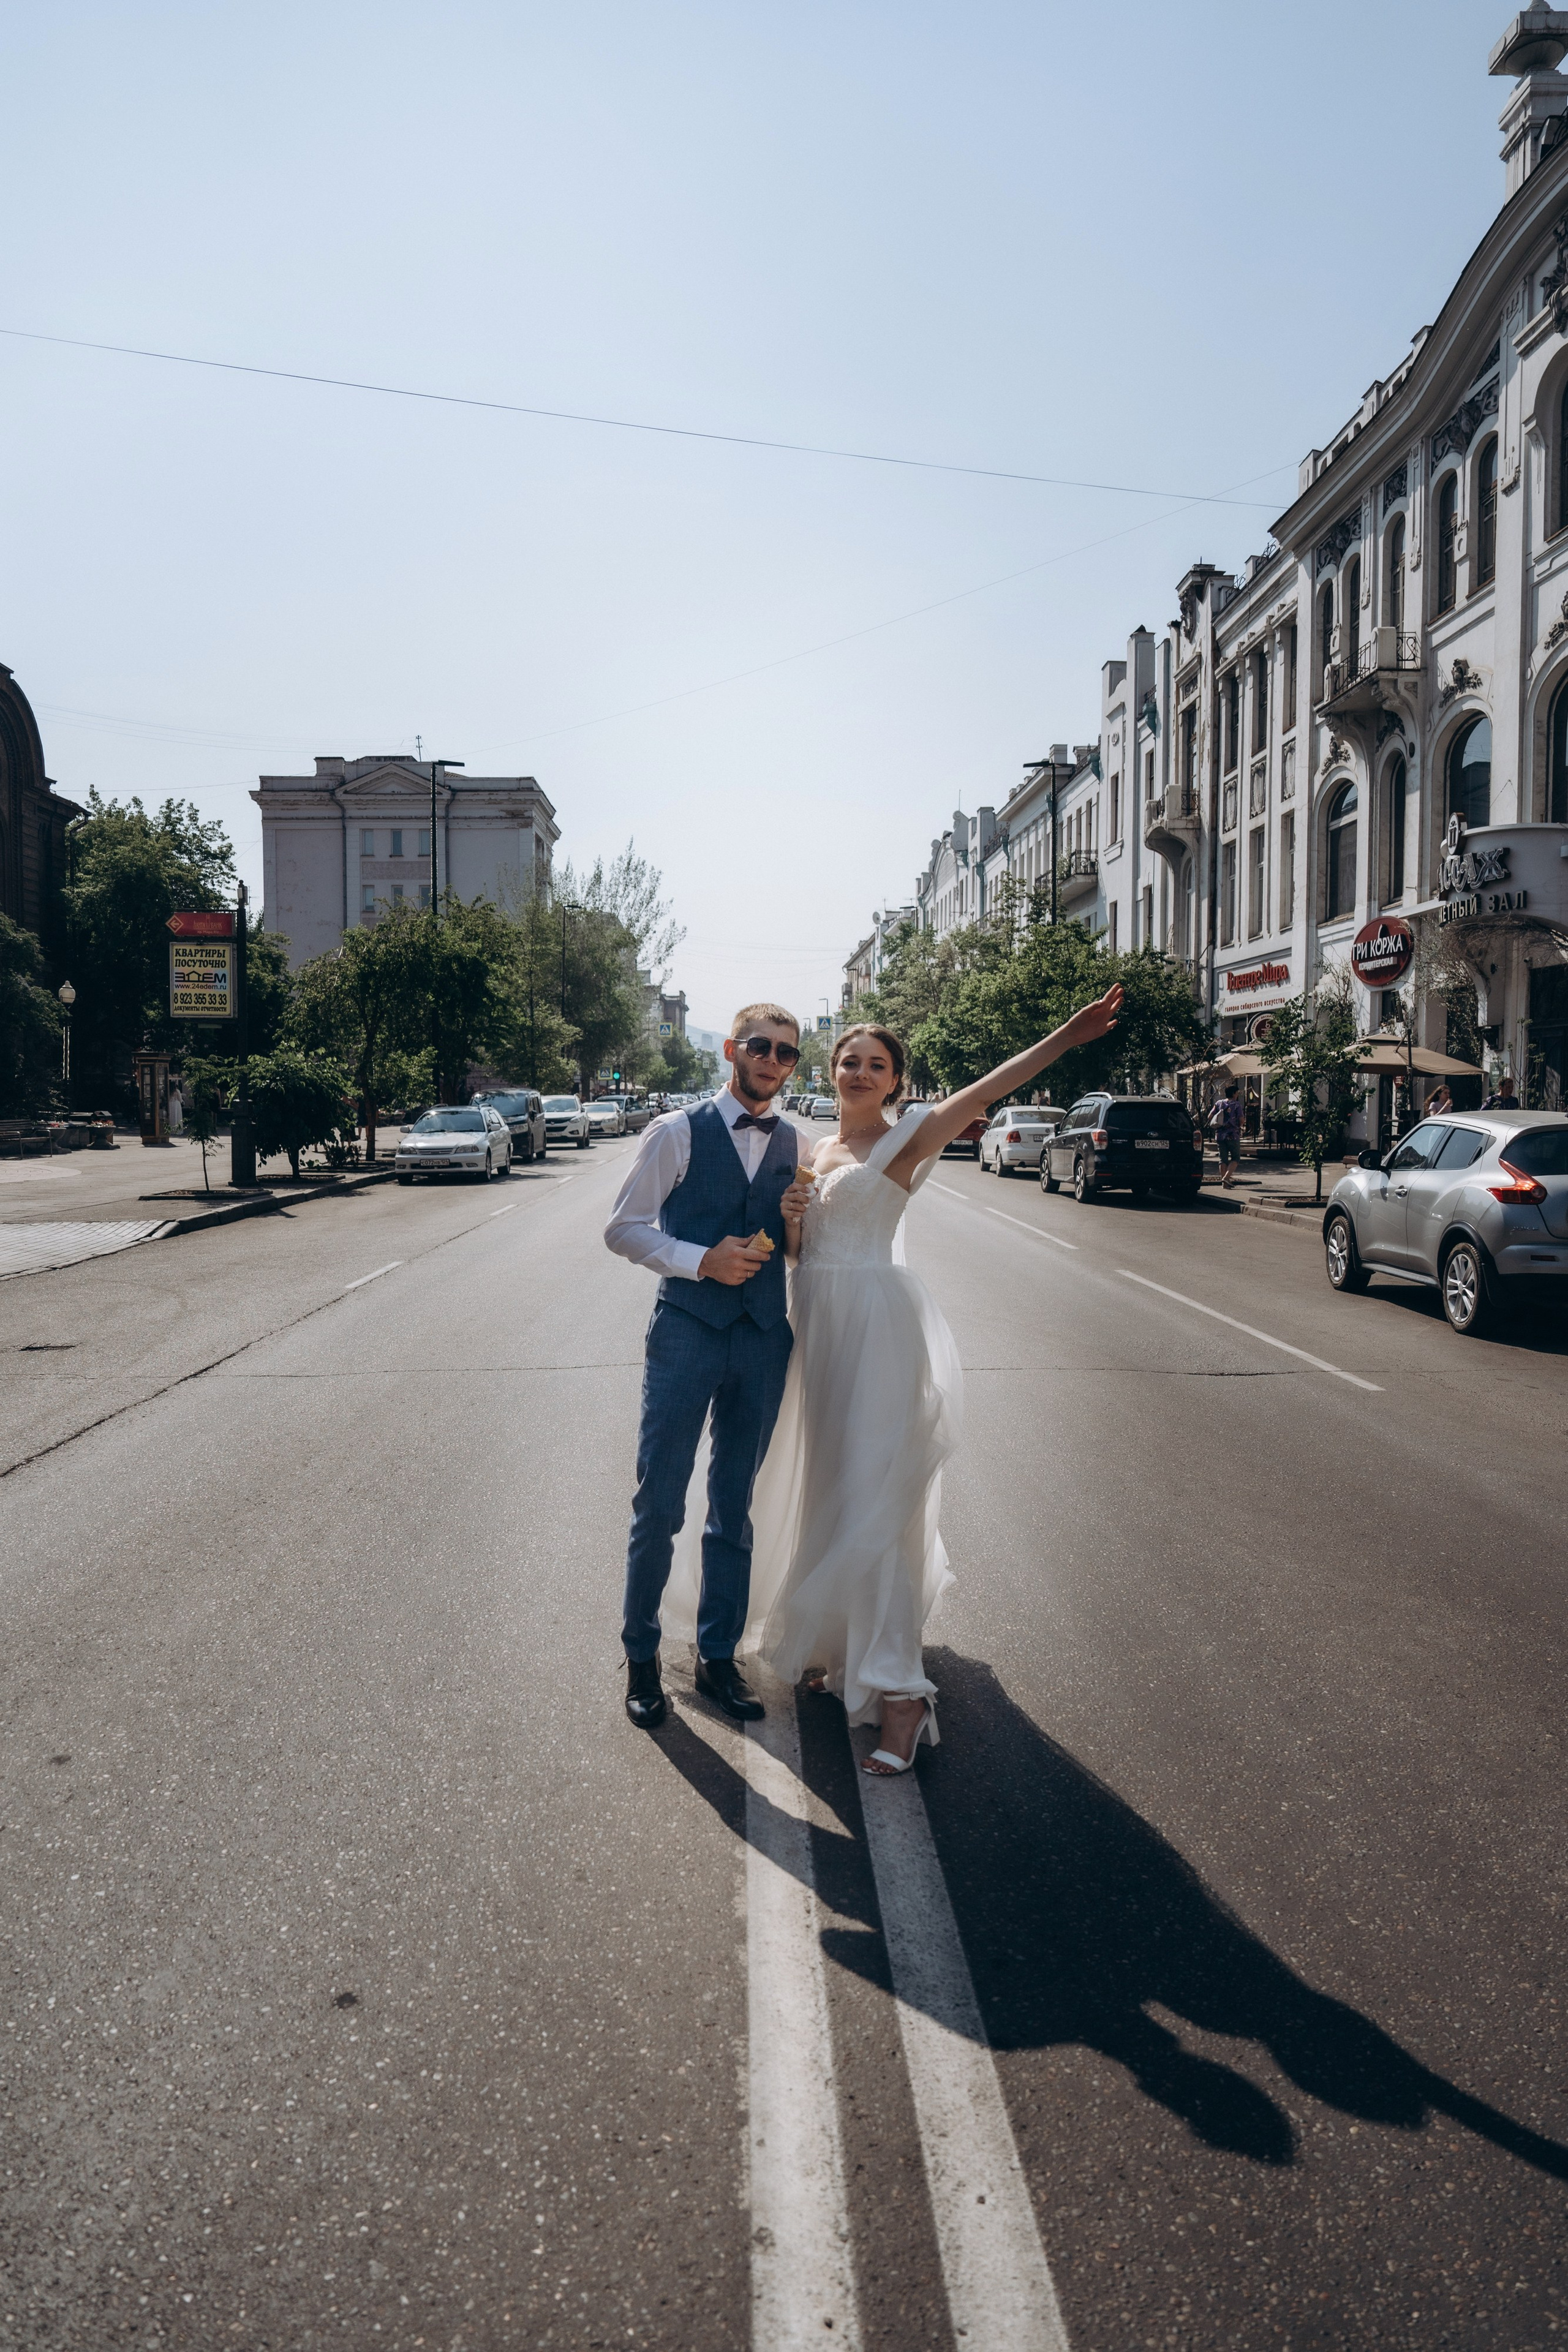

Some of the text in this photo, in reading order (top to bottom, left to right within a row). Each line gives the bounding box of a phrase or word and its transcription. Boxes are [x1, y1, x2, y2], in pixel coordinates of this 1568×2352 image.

[1488, 890, 1524, 913] ЗАЛ
[175, 948, 226, 958] КВАРТИРЫ
[1352, 933, 1403, 960] ТРИ КОРЖА
[175, 959, 227, 968] ПОСУТОЧНО
[1359, 957, 1393, 971] КОНДИТЕРСКАЯ
[175, 970, 227, 984] ЭДЕМ
[1262, 962, 1289, 986] Мира
[174, 992, 227, 1005] 8 923 355 33 33
[1240, 1001, 1263, 1010] сибирского
[1264, 997, 1285, 1006] искусства
